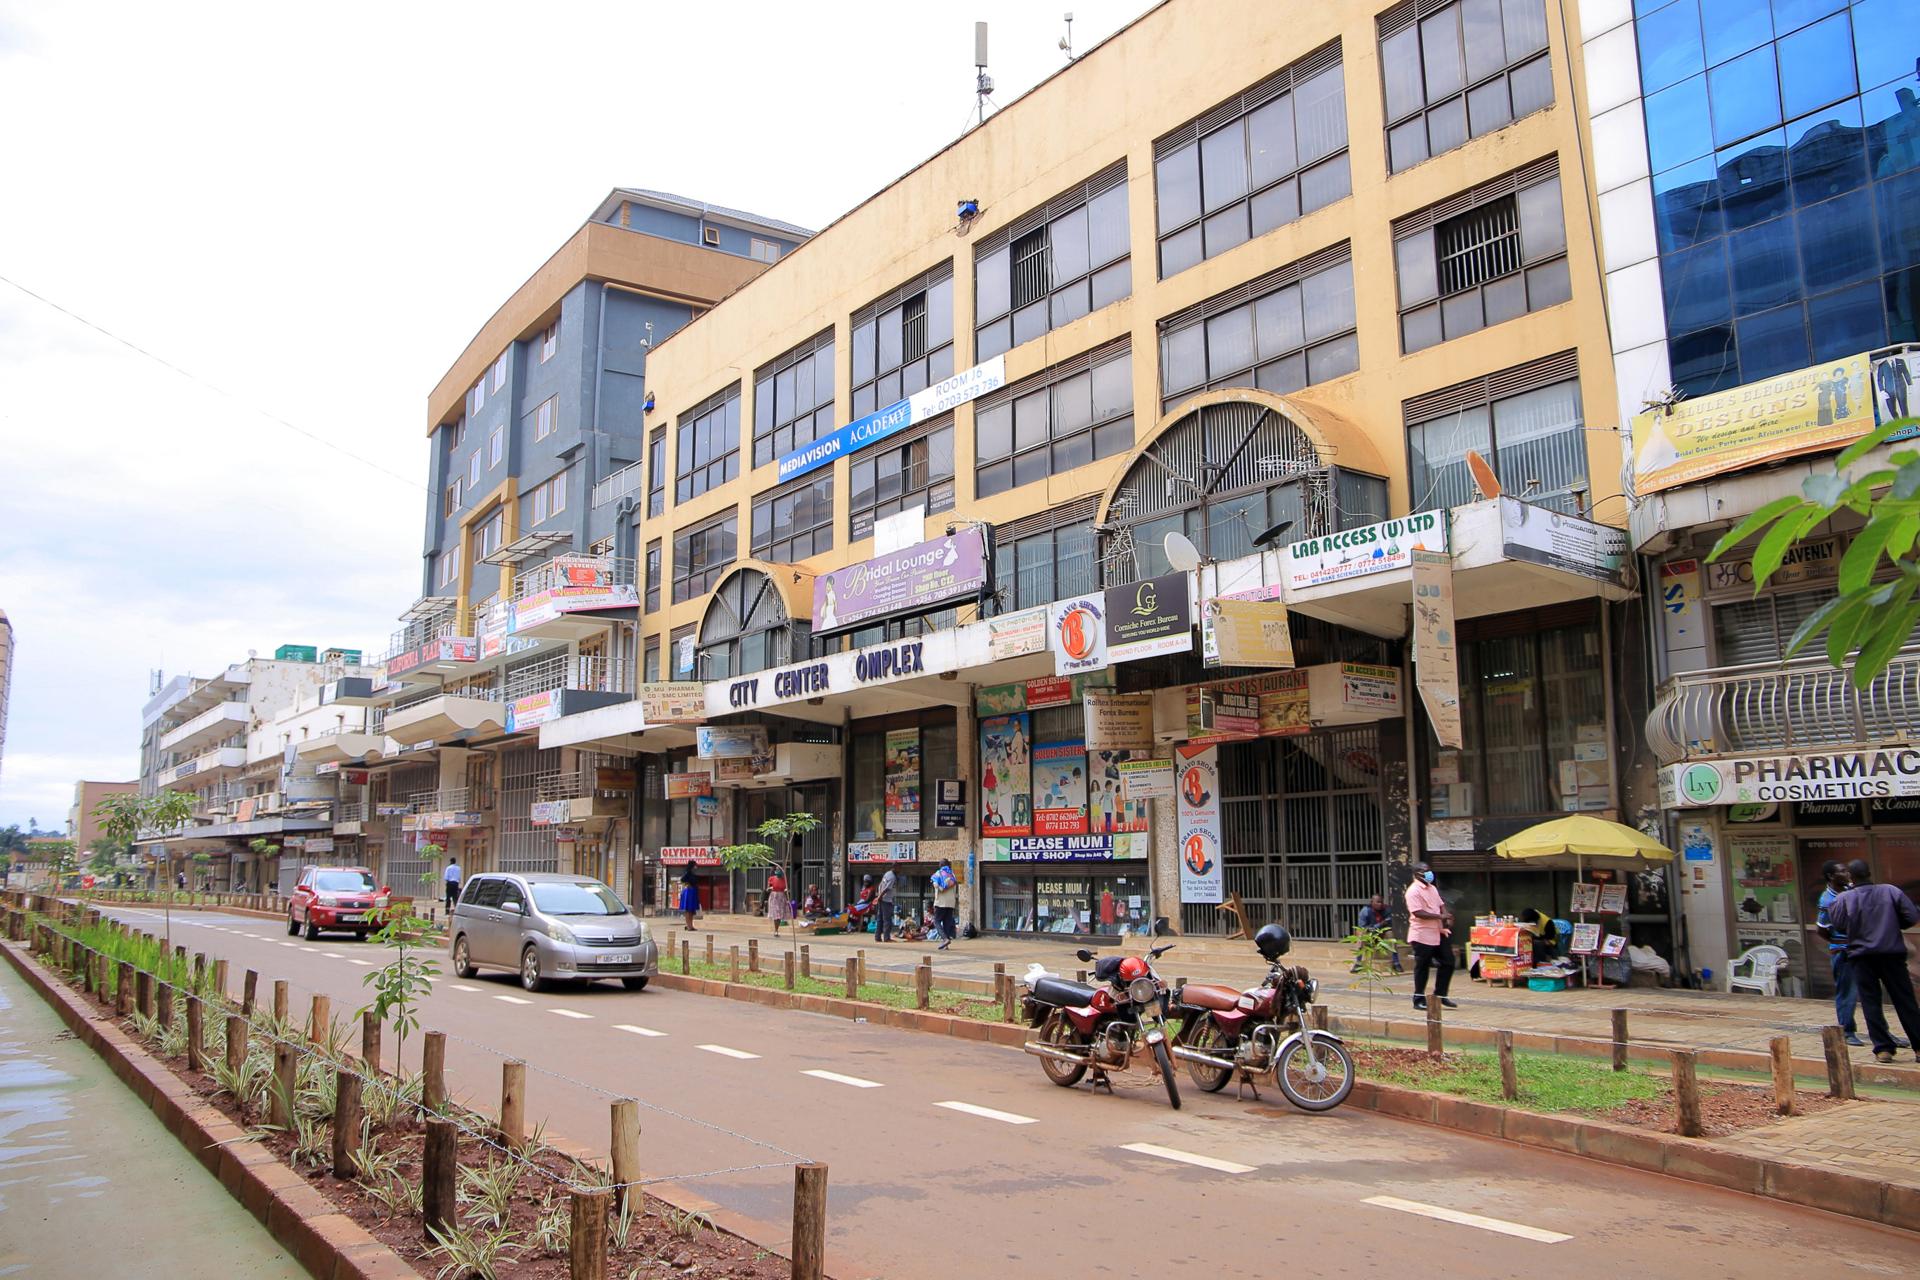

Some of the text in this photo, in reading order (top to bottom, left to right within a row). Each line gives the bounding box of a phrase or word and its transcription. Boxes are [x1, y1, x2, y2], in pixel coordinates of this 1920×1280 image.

[935, 374, 968, 398] ROOM
[938, 395, 962, 412] 0703
[963, 387, 980, 405] 573
[981, 378, 999, 395] 736
[1743, 371, 1818, 404] ELEGANT
[1676, 393, 1807, 438] DESIGNS
[779, 406, 907, 476] MEDIAVISION ACADEMY
[1291, 512, 1436, 560] LAB ACCESS (U) LTD
[1782, 541, 1835, 566] EAVENLY
[843, 547, 944, 600] Bridal Lounge
[1293, 573, 1310, 583] TEL:
[1310, 563, 1353, 579] 0414230777
[1357, 557, 1377, 570] 0772
[1235, 587, 1273, 601] BOUTIQUE
[1140, 618, 1157, 628] Forex
[1157, 614, 1179, 624] Bureau
[1110, 647, 1134, 657] GROUND
[1133, 644, 1153, 655] FLOOR
[1157, 639, 1175, 649] ROOM
[730, 641, 924, 709] CITY CENTER OMPLEX
[1026, 678, 1049, 690] GOLDEN
[1238, 671, 1308, 694] RESTAURANT
[1222, 693, 1247, 707] DIGITAL
[1099, 708, 1140, 717] Forex Bureau
[1033, 745, 1087, 760] GOLDEN SISTERS
[1131, 761, 1153, 769] ACCESS
[1178, 759, 1216, 781] BRAVO SHOES
[1758, 779, 1891, 801] COSMETICS
[1800, 800, 1858, 816] Pharmacy
[1011, 834, 1113, 852] PLEASE MUM !
[1180, 827, 1218, 846] BRAVO SHOES
[662, 847, 707, 858] OLYMPIA
[1011, 851, 1042, 861] BABY
[1043, 850, 1073, 861] SHOP
[1037, 882, 1063, 895] PLEASE
[1065, 882, 1083, 895] MUM
